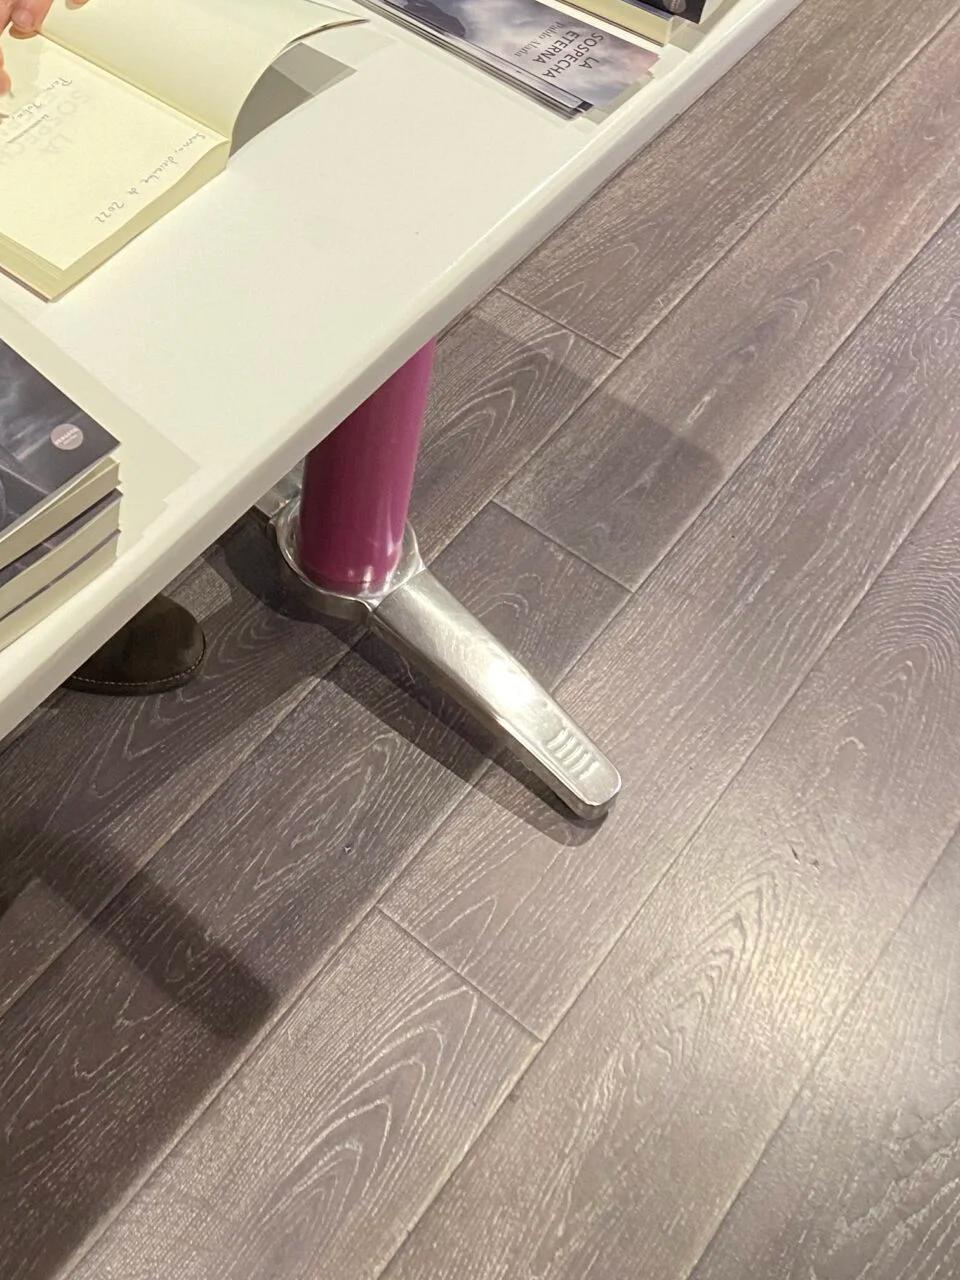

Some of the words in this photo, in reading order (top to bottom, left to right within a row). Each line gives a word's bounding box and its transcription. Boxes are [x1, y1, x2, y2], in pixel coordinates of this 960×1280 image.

[538, 21, 564, 40] Pablo
[532, 30, 580, 64] ETERNA
[541, 32, 604, 78] SOSPECHA
[579, 56, 600, 70] LA
